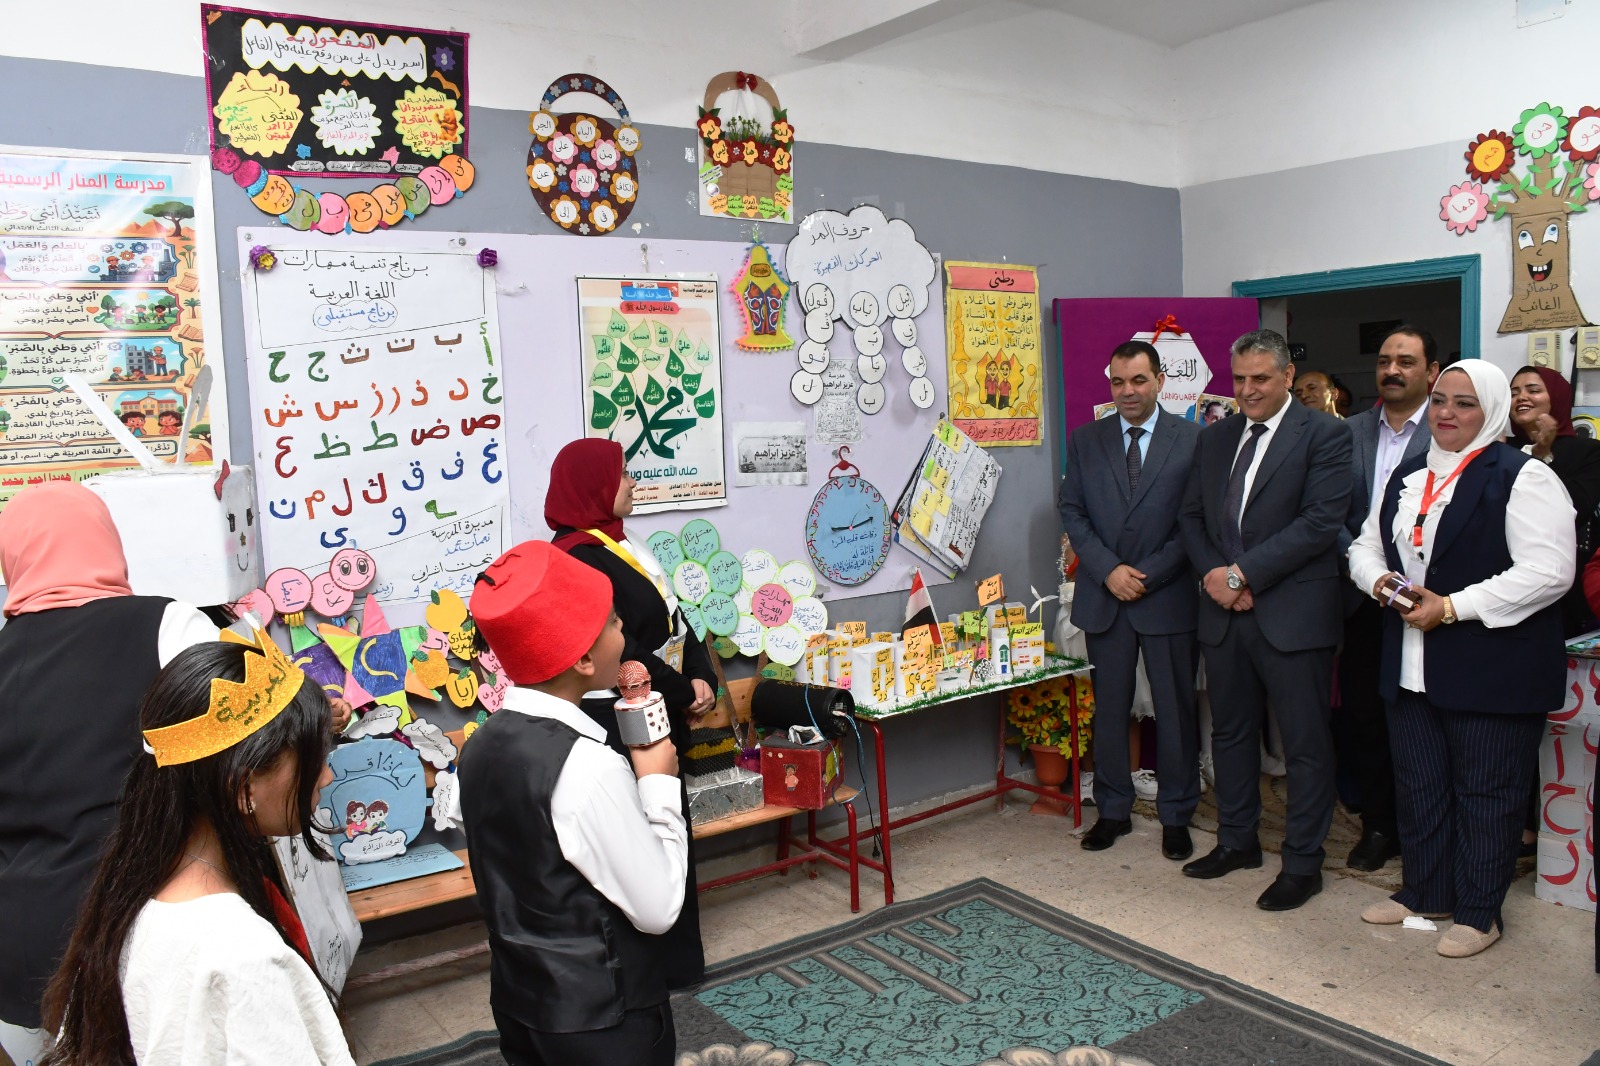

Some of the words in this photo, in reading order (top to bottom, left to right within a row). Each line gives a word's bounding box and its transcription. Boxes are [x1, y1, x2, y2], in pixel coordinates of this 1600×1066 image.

[286, 35, 305, 43] به
[309, 33, 375, 49] المفعول
[536, 120, 552, 131] الجر
[577, 127, 593, 138] الباء
[1531, 122, 1552, 140] هن
[555, 141, 569, 152] على
[618, 134, 638, 145] حروف
[599, 150, 613, 160] من
[68, 172, 108, 191] المنار
[114, 175, 166, 193] مدرسة
[537, 170, 549, 178] عن
[577, 175, 593, 184] اللام
[616, 182, 634, 192] الكاف
[559, 207, 569, 218] إلى
[1451, 198, 1476, 213] هما
[811, 221, 835, 245] المد
[833, 224, 870, 240] حروف
[284, 249, 347, 272] مهارات
[349, 255, 387, 271] تنمية
[388, 255, 429, 280] برنامج
[814, 255, 842, 277] القصيرة
[845, 248, 882, 271] الحركات
[309, 280, 360, 305] العربية
[364, 281, 396, 300] اللغة
[1522, 282, 1558, 300] ضمائر
[367, 302, 395, 322] برنامج
[1519, 296, 1560, 314] الغائب
[386, 337, 415, 353] ت
[434, 332, 462, 353] ب
[479, 320, 494, 367] أ
[339, 342, 370, 365] ث
[268, 350, 290, 383] ح
[307, 350, 330, 382] ج
[411, 379, 429, 407] ذ
[448, 377, 469, 401] د
[481, 372, 503, 405] خ
[1161, 392, 1197, 401] LANGUAGE
[264, 393, 303, 427] ش
[314, 398, 359, 421] س
[369, 382, 384, 419] ز
[388, 386, 401, 416] ر
[411, 418, 450, 446] ض
[461, 413, 501, 436] ص
[313, 432, 351, 460] ظ
[362, 420, 398, 452] ط
[274, 435, 298, 478] ع
[481, 437, 503, 484] غ
[780, 450, 796, 459] عزيز
[401, 460, 425, 491] ق
[441, 451, 464, 481] ف
[643, 468, 662, 480] عليه
[679, 466, 698, 475] صلى
[331, 477, 353, 517] ل
[362, 472, 388, 505] ك
[269, 498, 296, 520] ن
[304, 489, 326, 520] م
[388, 506, 407, 536] و
[464, 520, 493, 534] مديرة
[431, 522, 461, 542] المدرسة
[445, 553, 492, 572] تحت
[784, 576, 812, 588] الشعر
[758, 589, 791, 606] مهارات
[760, 598, 783, 615] اللغة
[758, 607, 779, 622] العربية
[455, 674, 474, 701] أيا
